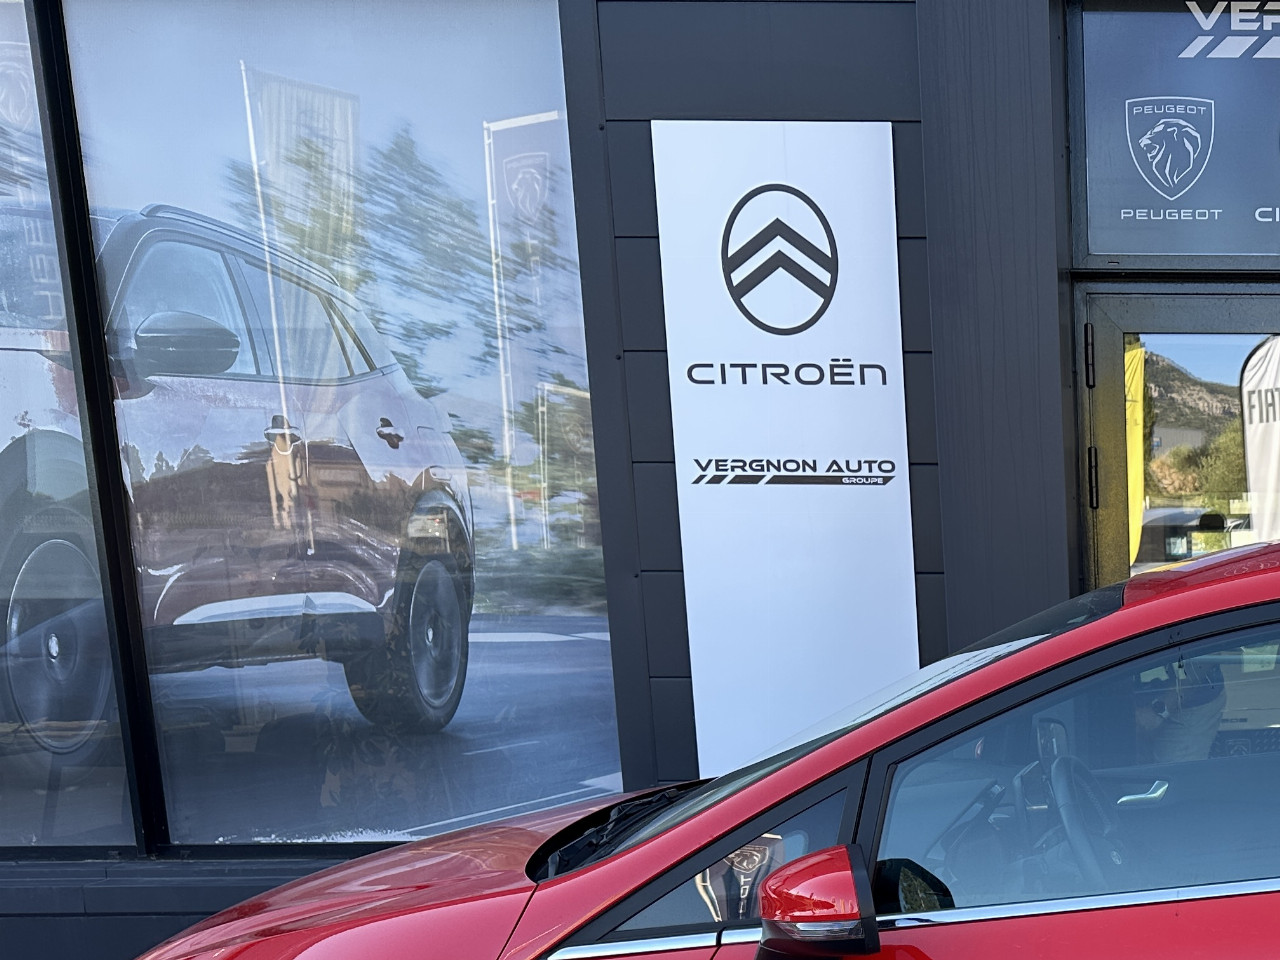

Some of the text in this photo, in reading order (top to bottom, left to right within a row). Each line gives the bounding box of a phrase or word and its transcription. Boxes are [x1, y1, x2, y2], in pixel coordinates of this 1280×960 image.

[1132, 104, 1207, 116] PEUGEOT
[1120, 208, 1223, 221] PEUGEOT
[693, 459, 896, 473] VERGNON AUTO
